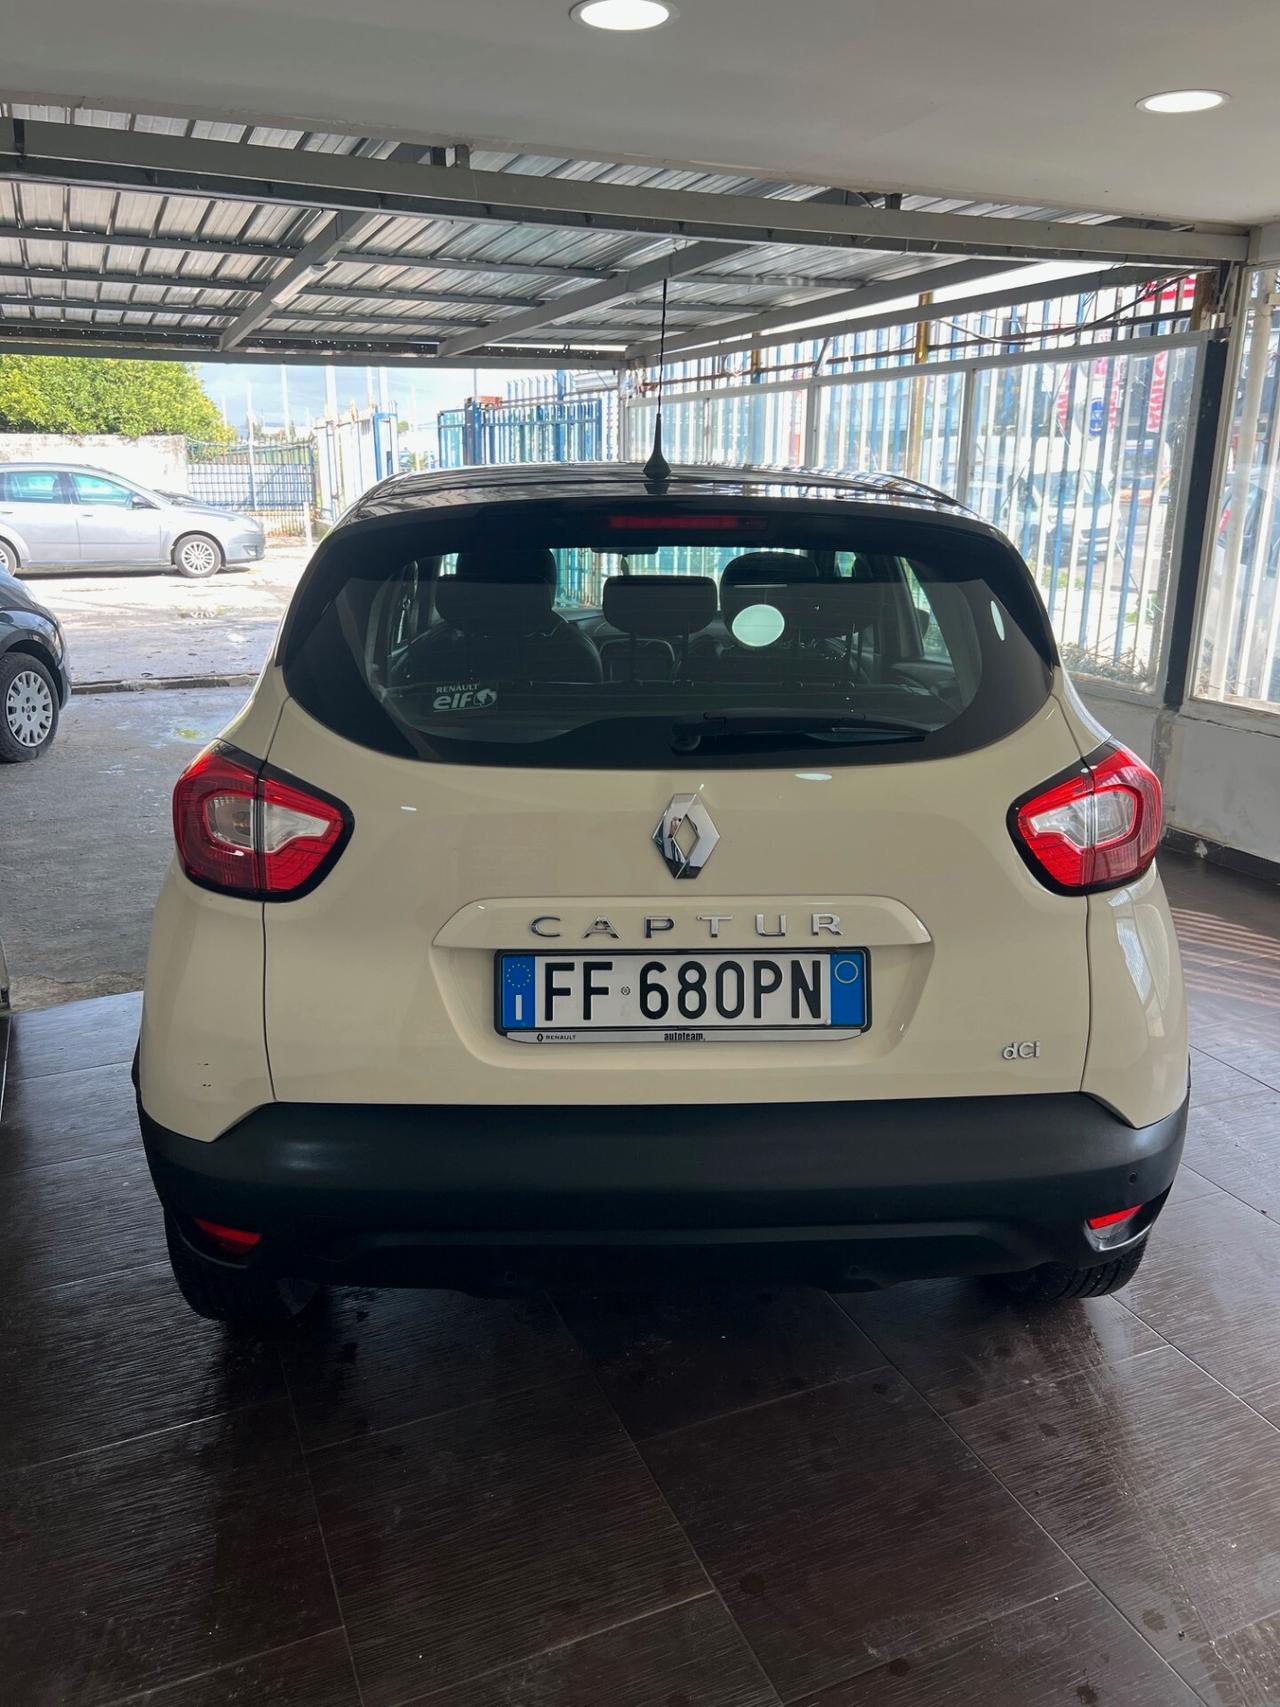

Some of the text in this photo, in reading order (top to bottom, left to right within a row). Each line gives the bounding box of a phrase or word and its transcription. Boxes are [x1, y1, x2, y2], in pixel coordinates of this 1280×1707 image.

[436, 683, 478, 693] RENAULT
[433, 691, 473, 710] elf
[529, 913, 844, 939] CAPTUR
[545, 961, 613, 1021] FF
[639, 960, 821, 1020] 680PN
[1002, 1040, 1040, 1060] dCi
